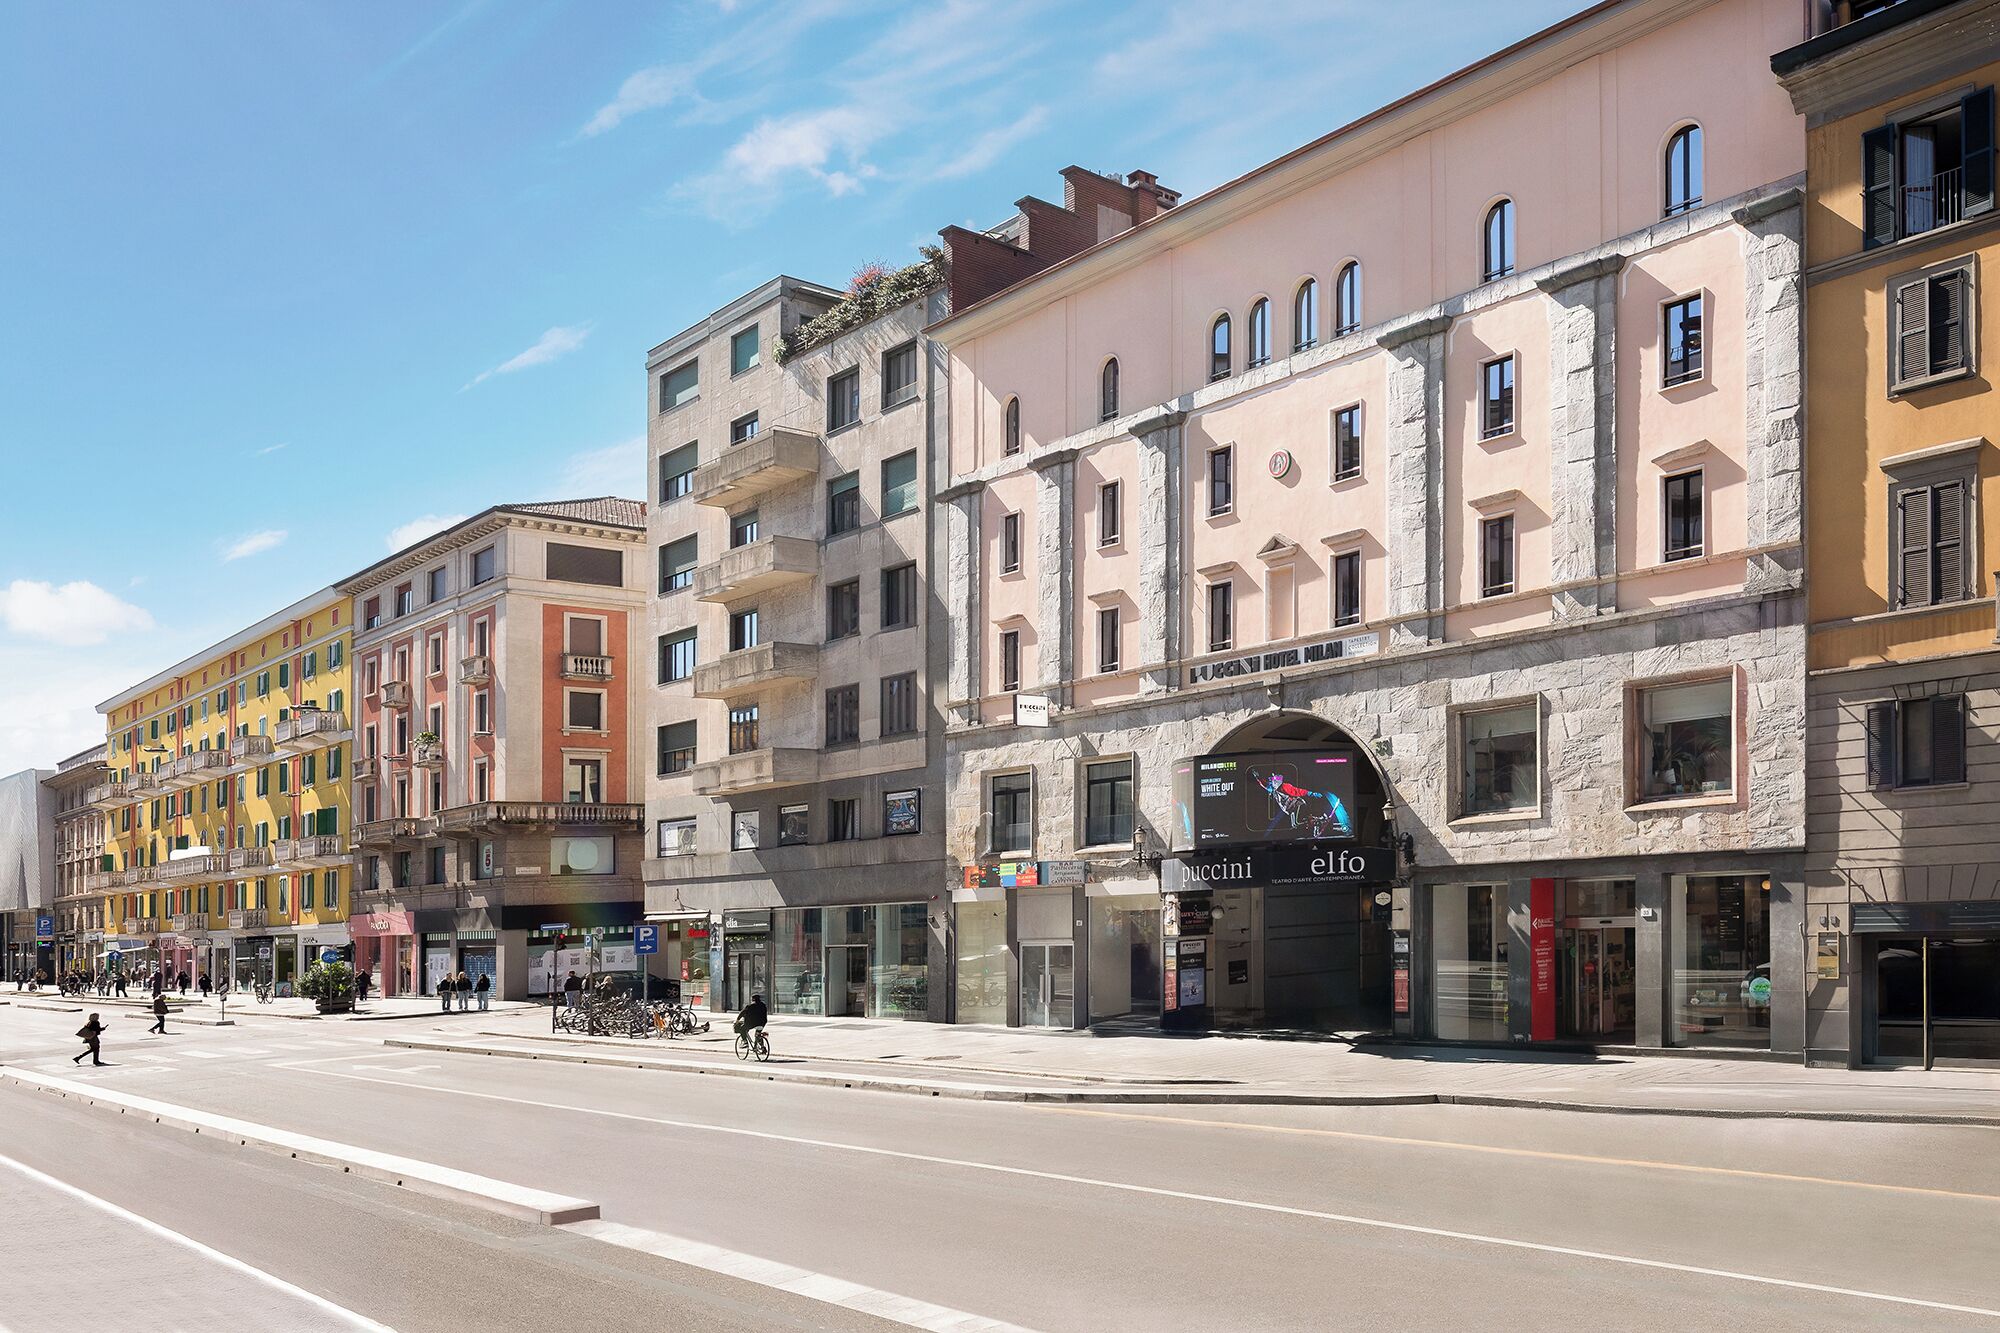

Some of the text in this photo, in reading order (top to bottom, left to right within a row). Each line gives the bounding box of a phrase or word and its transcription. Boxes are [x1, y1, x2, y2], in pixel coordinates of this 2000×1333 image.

[1190, 640, 1343, 684] PUCCINI HOTEL MILAN
[1201, 782, 1234, 793] WHITE OUT
[1311, 850, 1365, 876] elfo
[1182, 856, 1253, 888] puccini
[1312, 875, 1365, 883] CONTEMPORANEA
[585, 935, 591, 945] P
[639, 927, 653, 942] P
